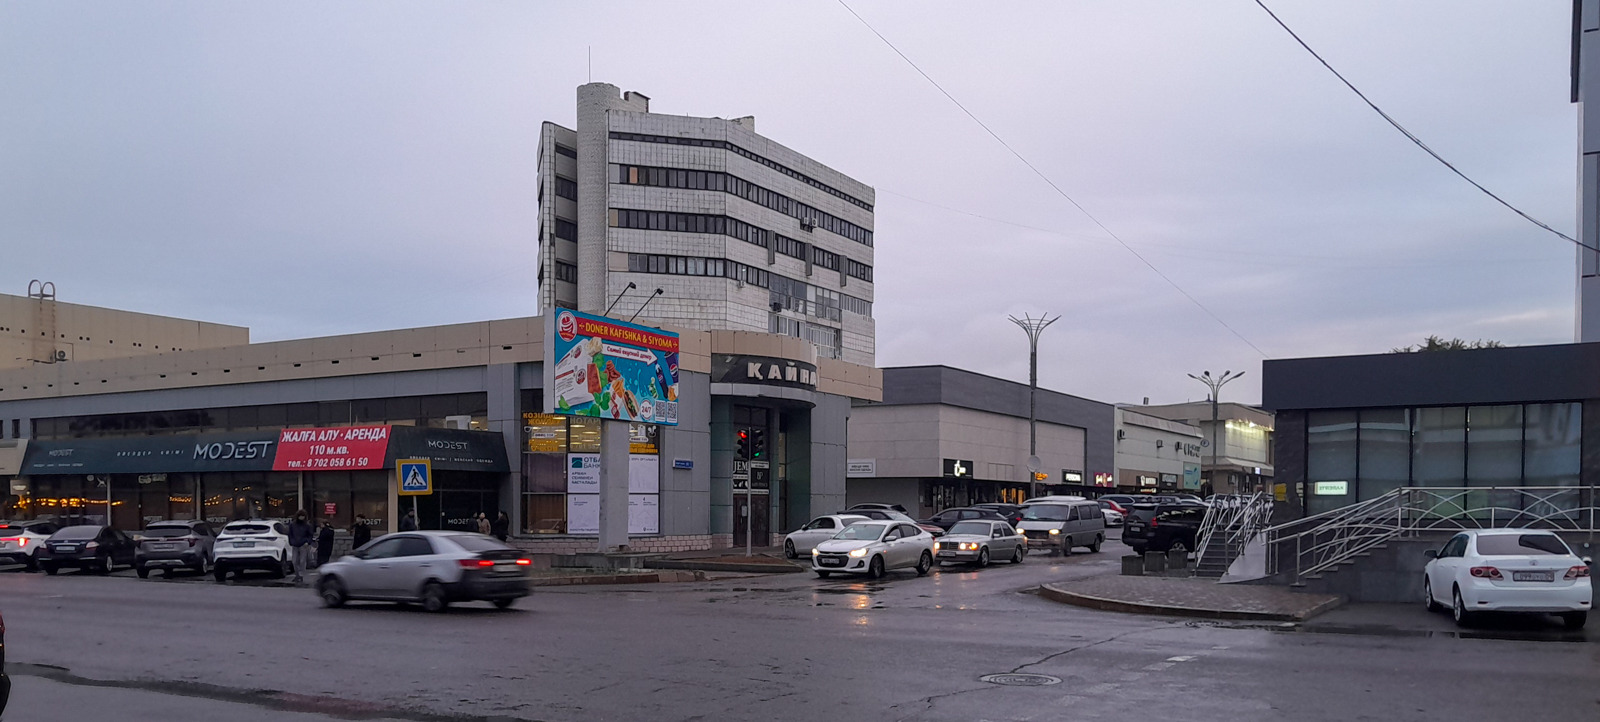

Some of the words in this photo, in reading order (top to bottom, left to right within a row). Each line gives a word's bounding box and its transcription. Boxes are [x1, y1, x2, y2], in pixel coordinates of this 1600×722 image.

[586, 322, 609, 336] DONER
[610, 327, 642, 342] KAFISHKA
[642, 334, 648, 343] &
[648, 336, 673, 348] SIYOMA
[606, 346, 622, 354] Самый
[641, 405, 652, 413] 24/7
[282, 430, 315, 442] ЖАЛҒА
[318, 428, 340, 442] АЛУ
[344, 427, 387, 442] АРЕНДА
[310, 444, 325, 454] 110
[326, 446, 350, 454] м.кв.
[428, 440, 468, 450] MODEST
[193, 440, 273, 461] MODEST
[287, 460, 306, 468] тел.:
[307, 458, 312, 468] 8
[314, 458, 328, 468] 702
[330, 458, 344, 467] 058
[346, 458, 356, 467] 61
[358, 457, 368, 466] 50
